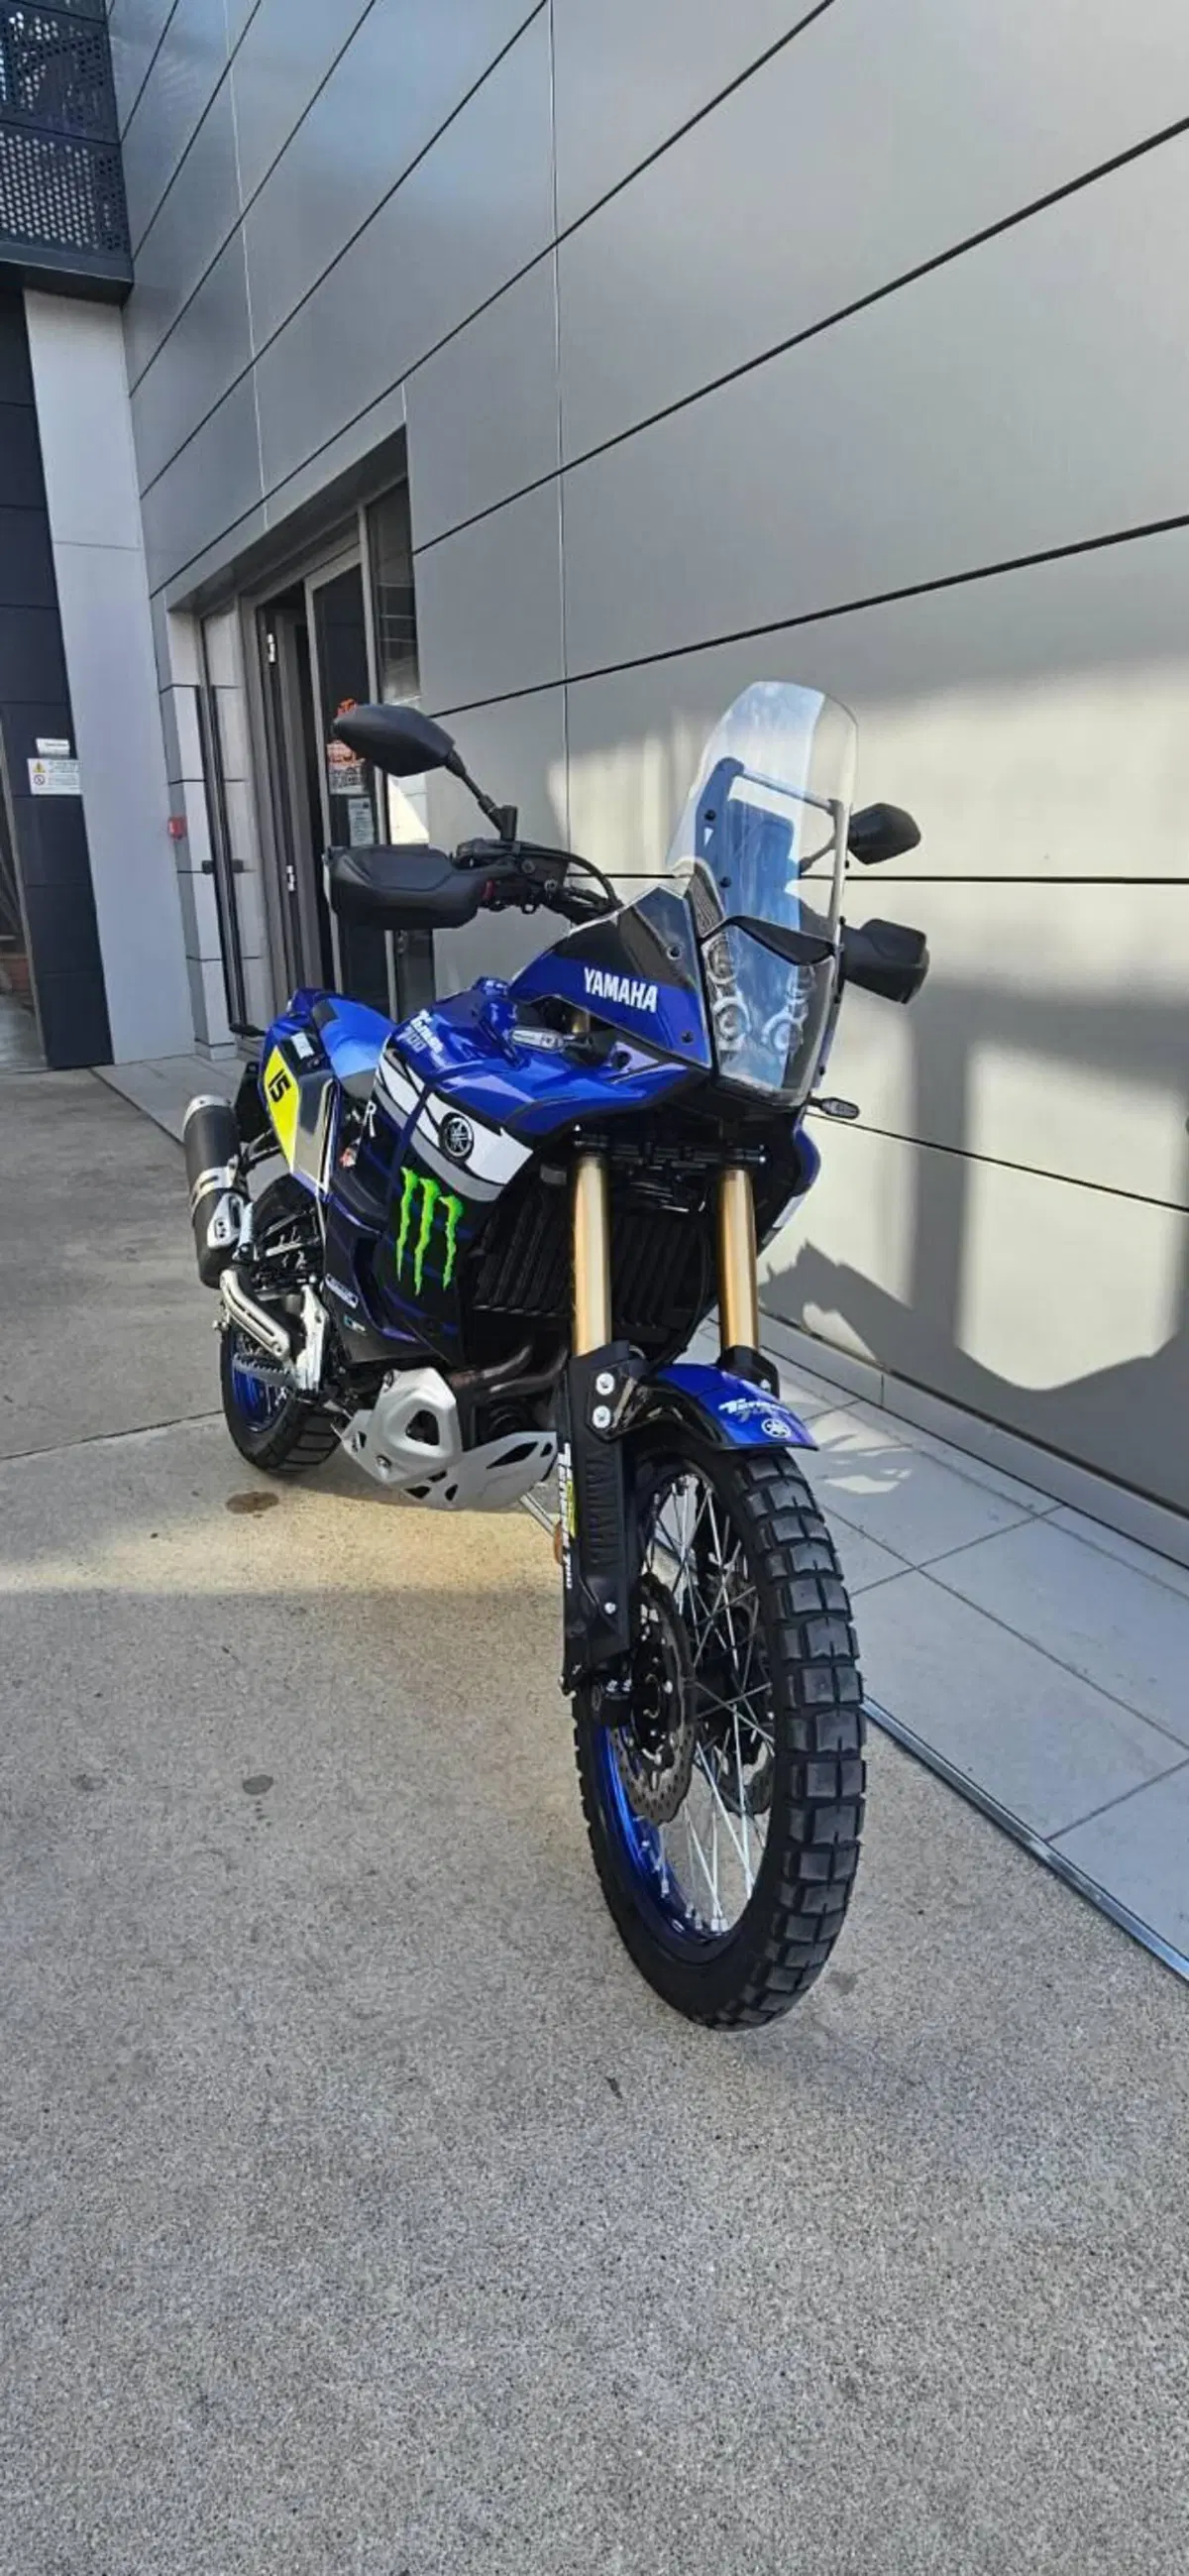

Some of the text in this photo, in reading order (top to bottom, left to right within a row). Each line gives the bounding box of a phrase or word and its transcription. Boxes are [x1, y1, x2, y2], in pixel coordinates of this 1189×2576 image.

[584, 966, 658, 1013] YAMAHA
[396, 1026, 427, 1053] 700
[268, 1068, 291, 1102] 15
